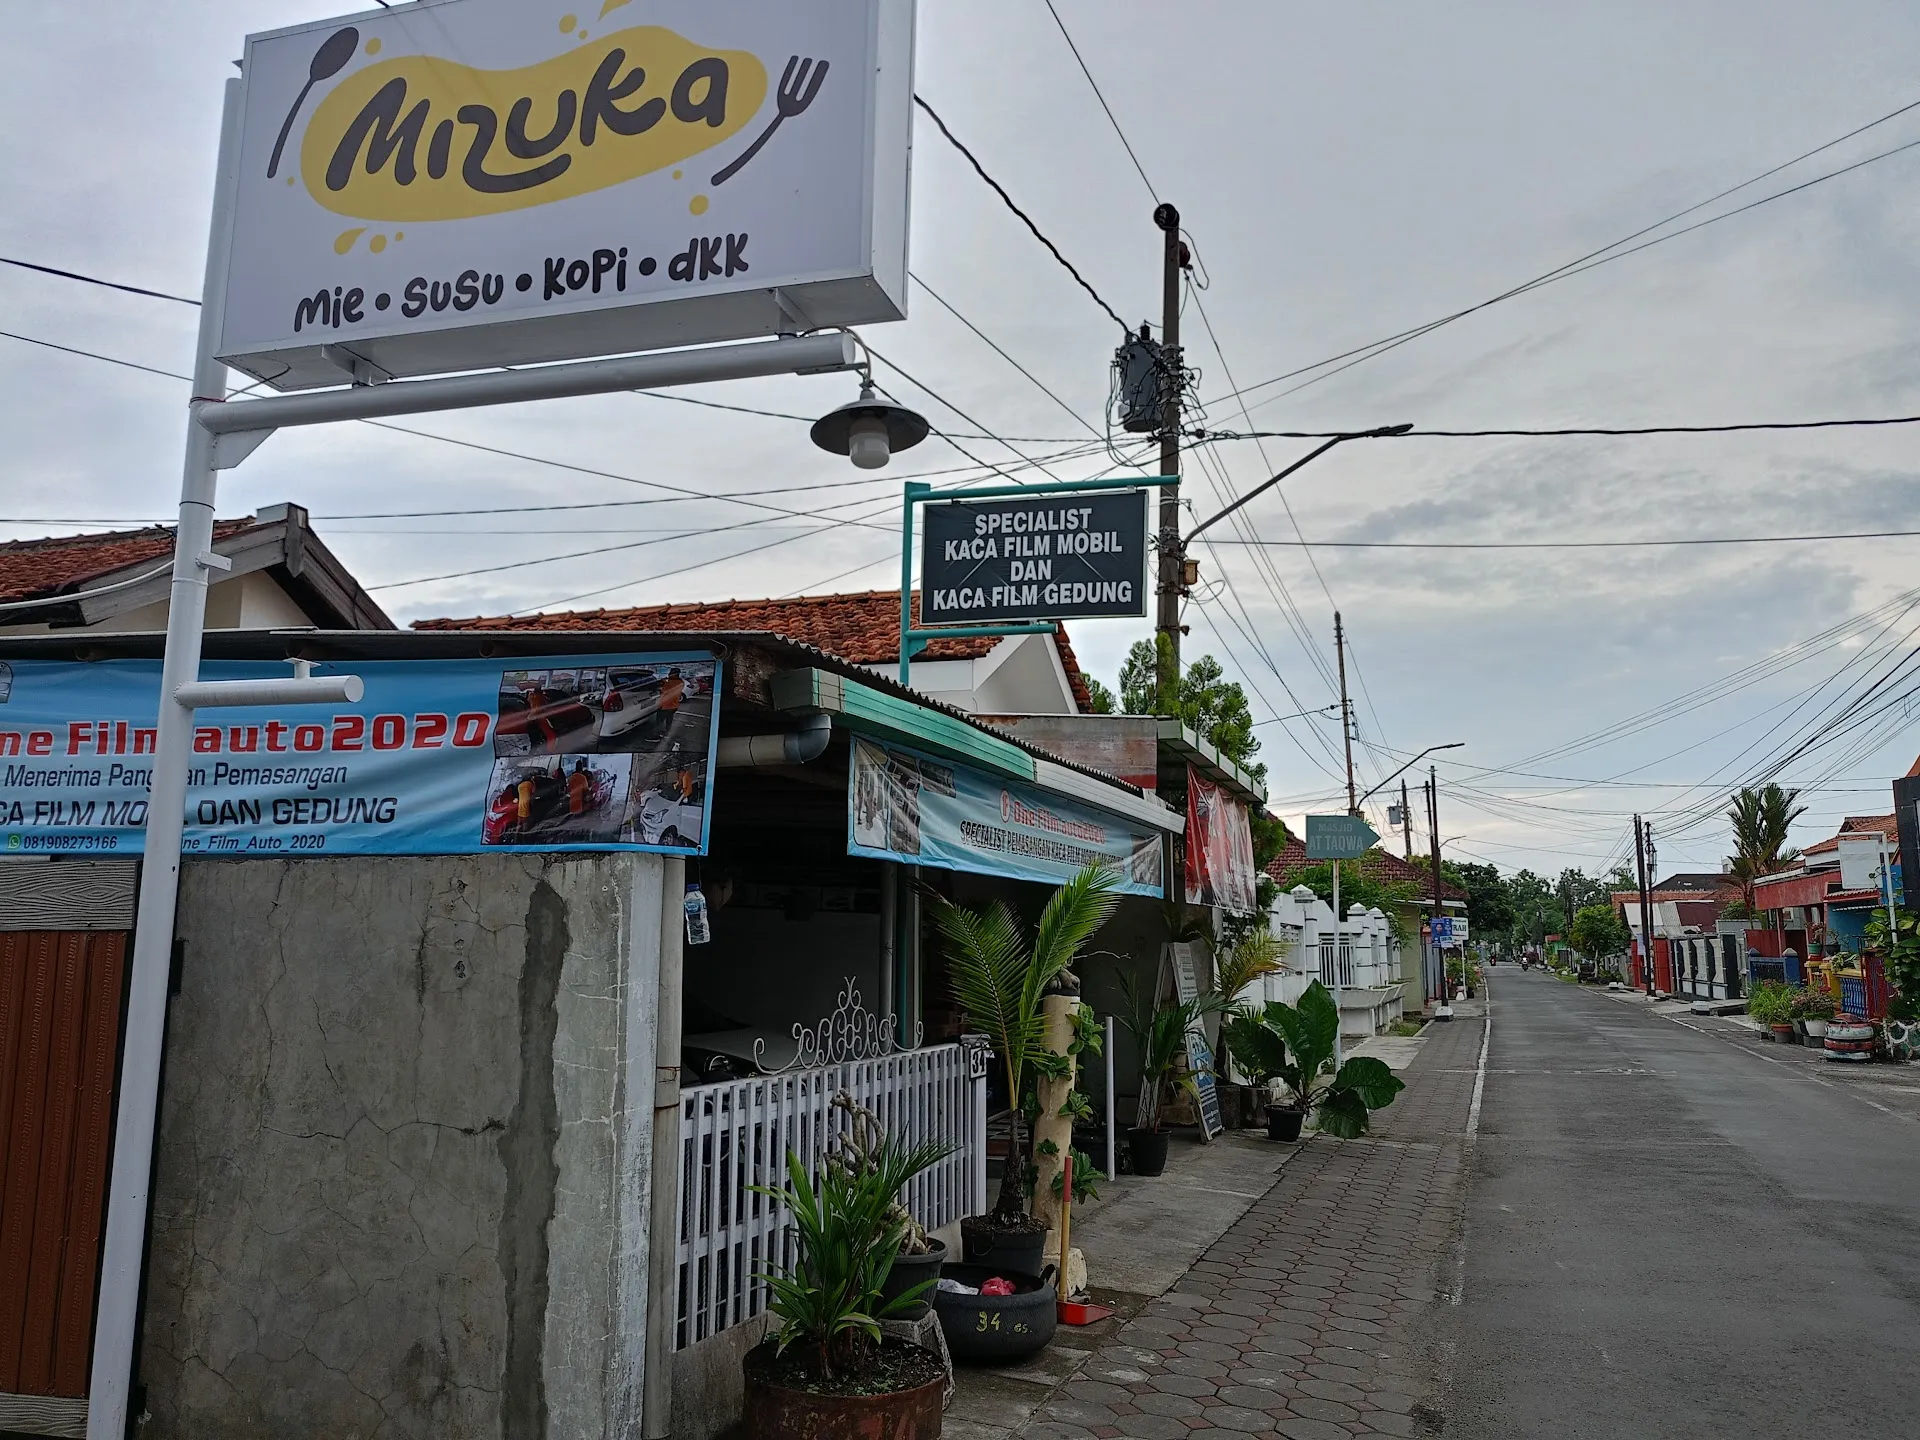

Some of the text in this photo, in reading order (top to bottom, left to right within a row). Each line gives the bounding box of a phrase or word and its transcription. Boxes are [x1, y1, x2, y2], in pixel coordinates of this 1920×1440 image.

[975, 508, 1092, 535] SPECIALIST
[945, 531, 1123, 561] KACA FILM MOBIL
[1010, 559, 1052, 582] DAN
[933, 581, 1132, 611] KACA FILM GEDUNG
[193, 711, 491, 754] auto2020
[4, 763, 100, 787] Menerima
[213, 762, 347, 790] Pemasangan
[32, 801, 96, 826] FILM
[272, 797, 398, 825] GEDUNG
[1014, 800, 1035, 827] One
[960, 820, 1006, 852] SPECIALIST
[1319, 823, 1353, 832] MASJID
[24, 833, 326, 852] 081908273166 ne_Film_Auto_2020
[1309, 836, 1364, 852] AT TAQWA
[976, 1311, 1000, 1332] 34
